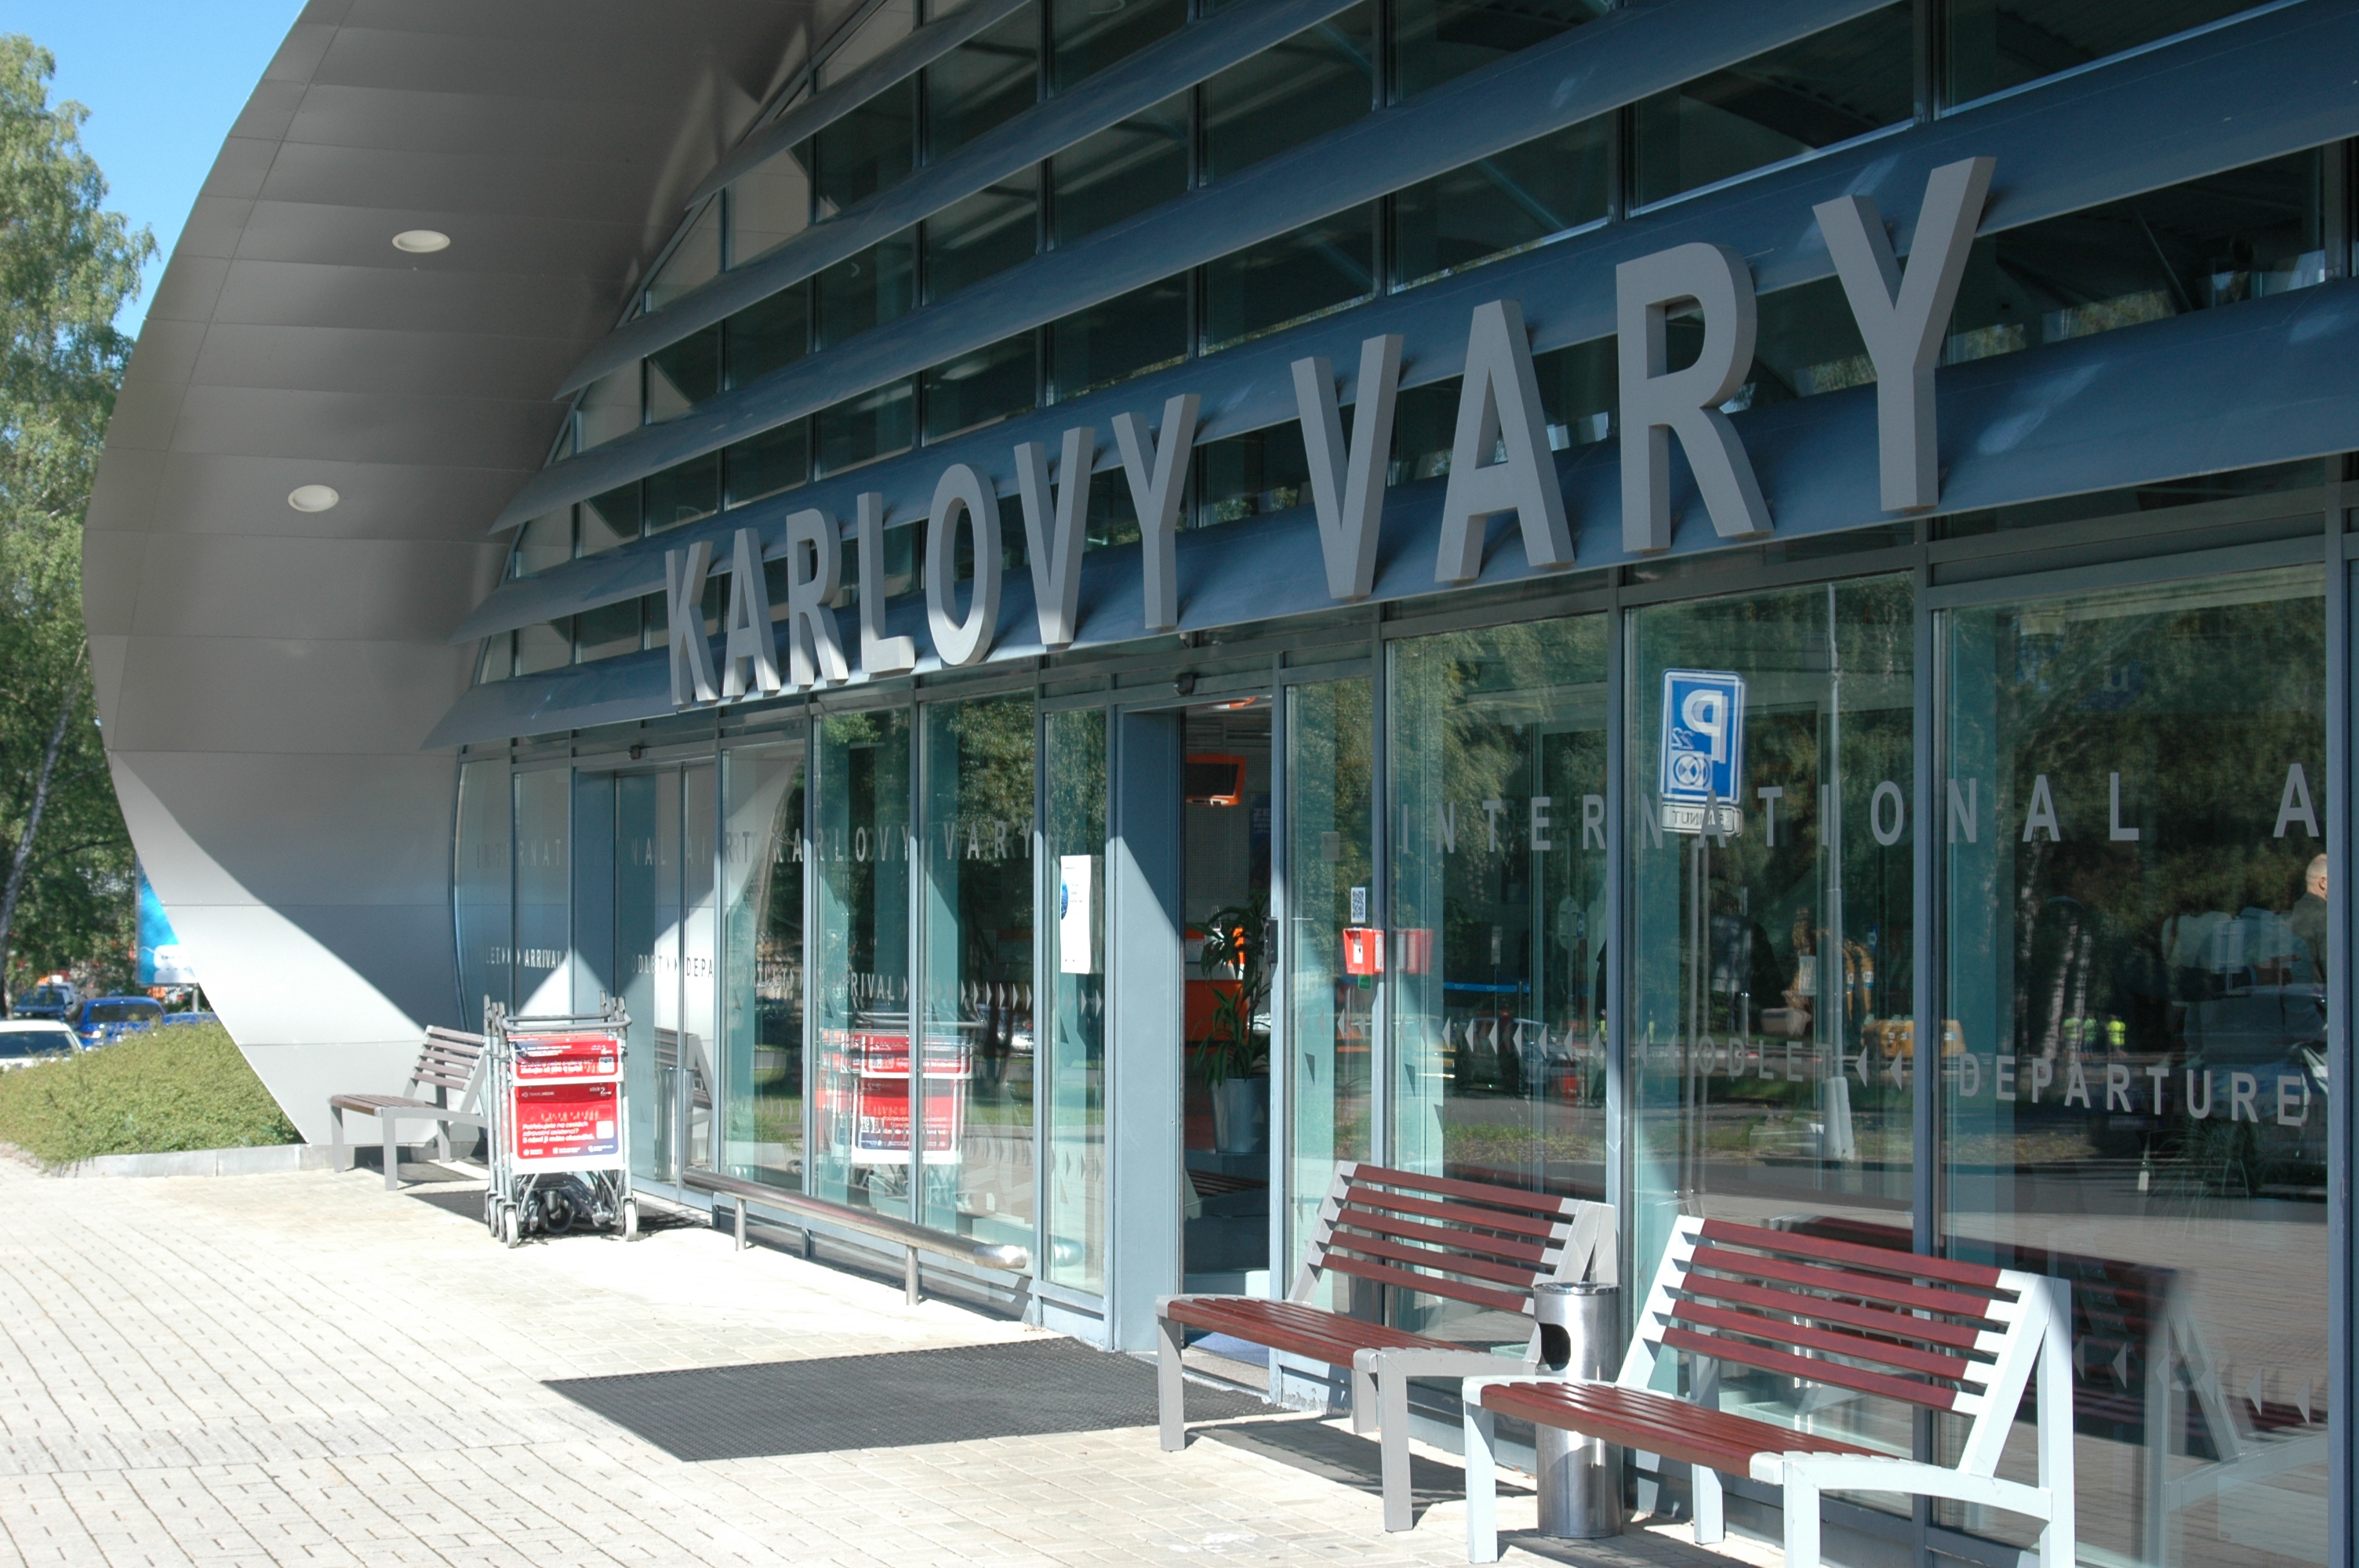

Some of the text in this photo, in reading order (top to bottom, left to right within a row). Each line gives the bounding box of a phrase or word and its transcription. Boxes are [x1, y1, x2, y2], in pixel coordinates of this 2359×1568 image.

[665, 155, 1997, 706] KARLOVY VARY
[772, 825, 911, 863] KARLOVY
[943, 817, 1034, 860] VARY
[1401, 771, 2140, 854] INTERNATIONAL
[1697, 1034, 2303, 1127] ODLET DEPARTURE
